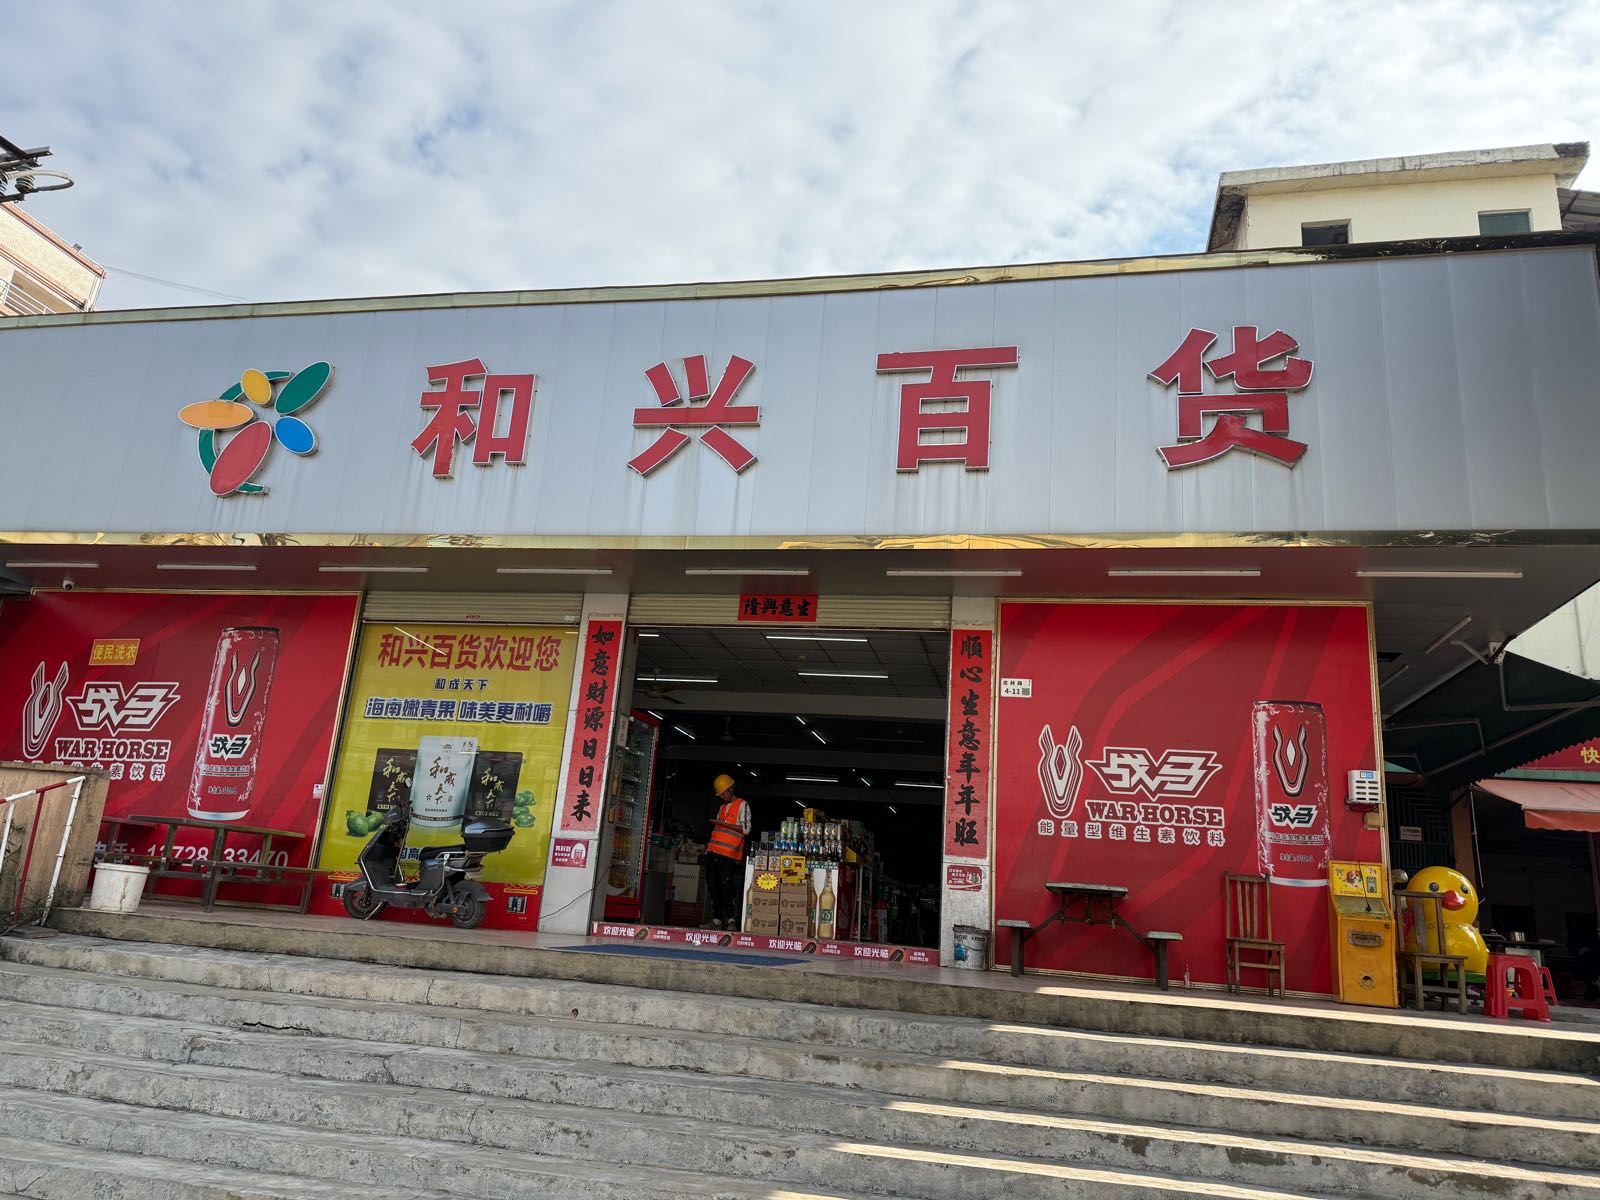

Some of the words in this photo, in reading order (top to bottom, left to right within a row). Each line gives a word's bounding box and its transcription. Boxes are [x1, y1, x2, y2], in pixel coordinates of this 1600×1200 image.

[411, 326, 1313, 478] 和兴百货
[93, 644, 138, 660] 便民洗衣
[377, 633, 562, 672] 和兴百货欢迎您
[434, 677, 488, 692] 和成天下
[72, 685, 175, 731] 战马
[365, 697, 457, 720] 海南嫩青果
[459, 701, 552, 723] 味美更耐嚼
[56, 739, 96, 760] WAR
[99, 740, 170, 762] HORSE
[1092, 750, 1215, 796] 战马
[1086, 801, 1138, 822] WAR
[1141, 804, 1224, 827] HORSE
[1038, 819, 1225, 846] 能量型维生素饮料
[603, 925, 635, 938] 欢迎光临
[768, 939, 802, 951] 欢迎光临
[854, 947, 889, 958] 欢迎光临
